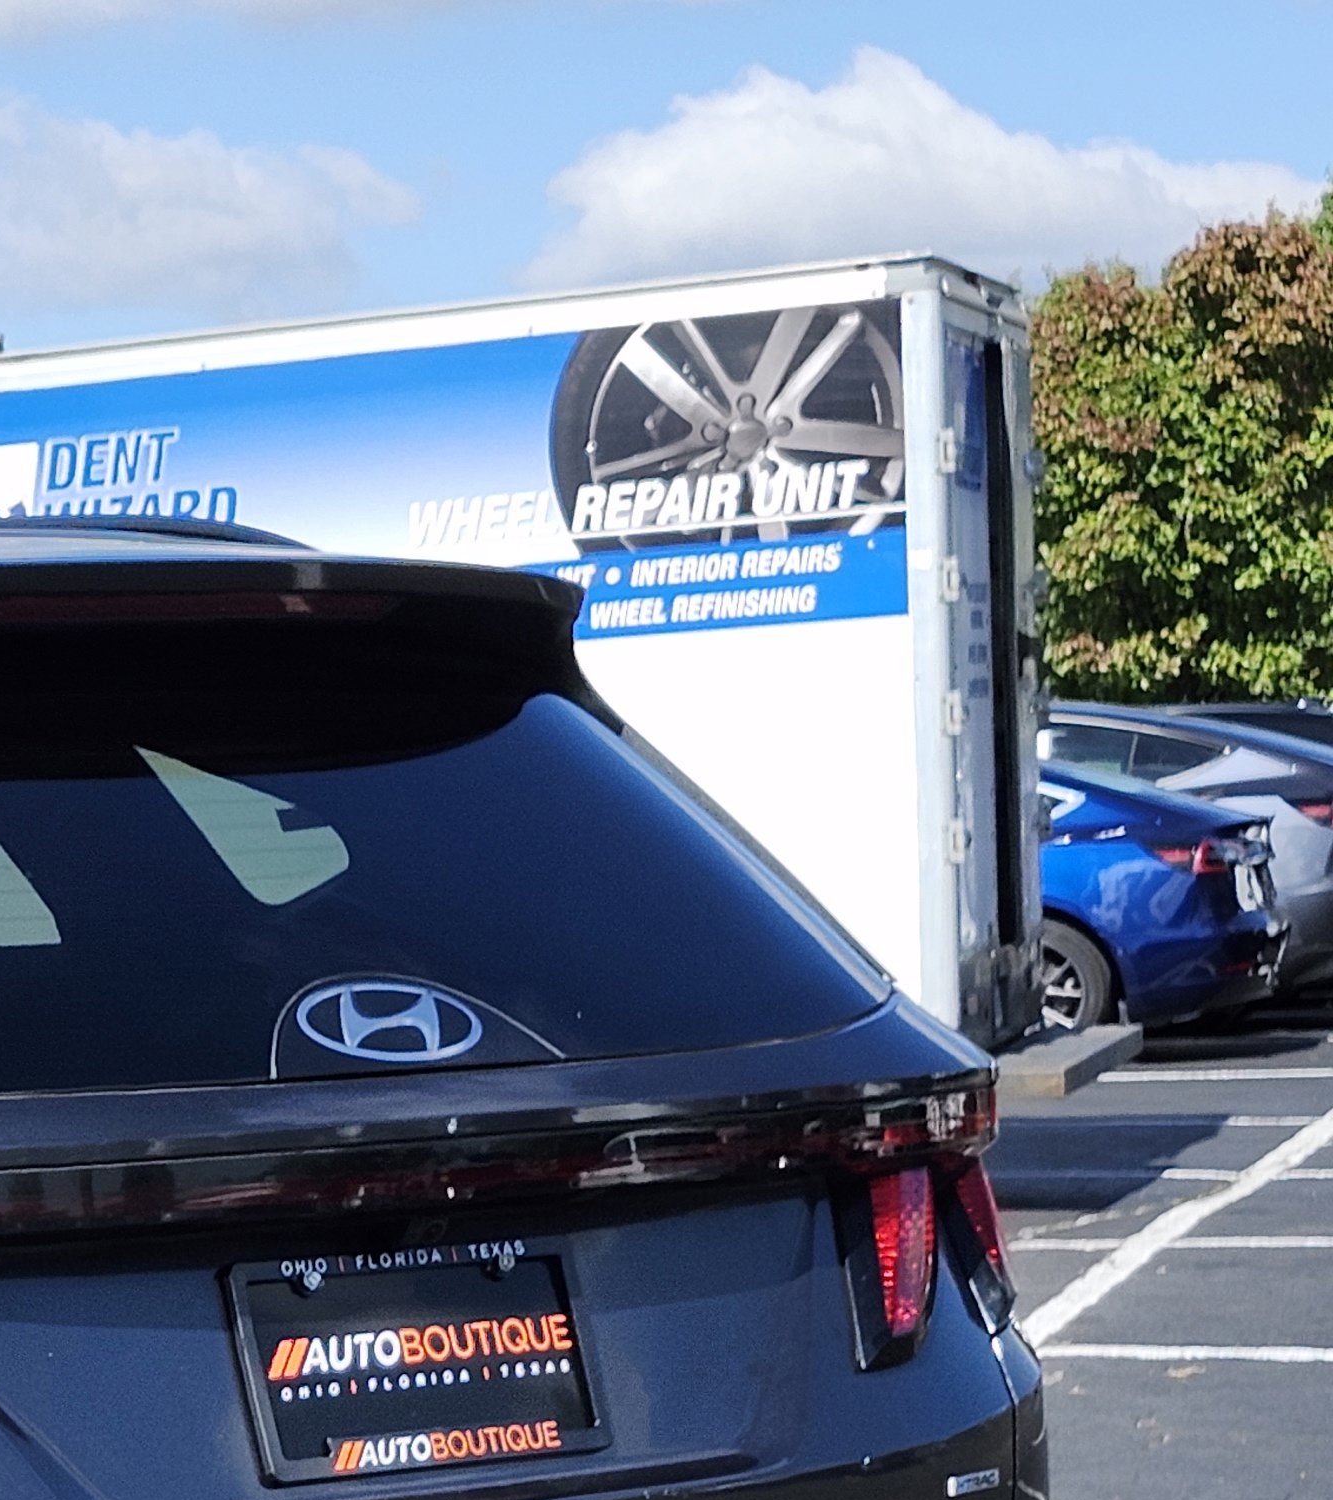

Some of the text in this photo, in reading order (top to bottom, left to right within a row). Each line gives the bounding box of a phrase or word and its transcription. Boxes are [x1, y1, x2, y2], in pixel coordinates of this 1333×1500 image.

[46, 431, 176, 490] DENT
[406, 458, 870, 549] WHEEL REPAIR UNIT
[630, 552, 740, 588] INTERIOR
[740, 543, 843, 579] REPAIRS
[590, 584, 817, 630] WHEEL REFINISHING
[281, 1239, 526, 1278] OHIO FLORIDA TEXAS
[302, 1314, 572, 1375] AUTOBOUTIQUE
[358, 1421, 562, 1468] AUTOBOUTIQUE
